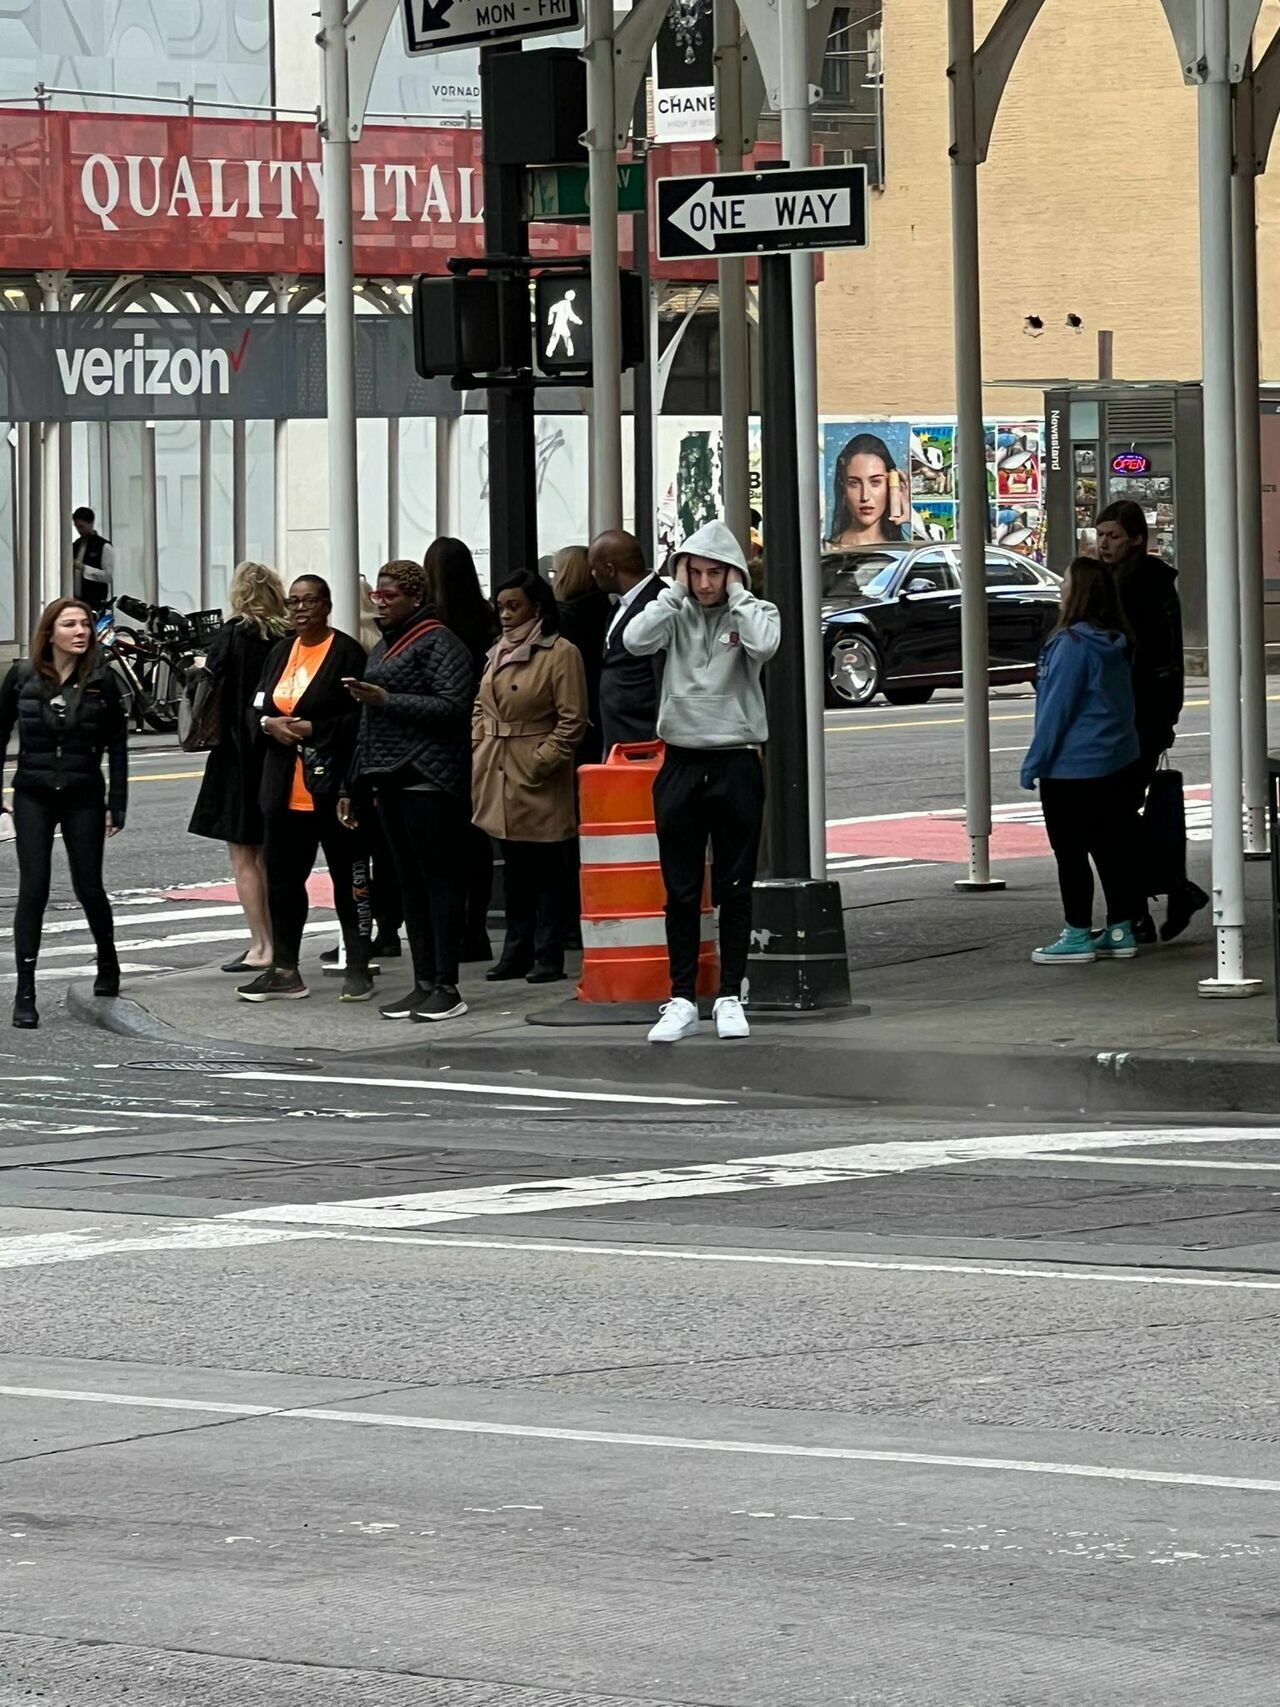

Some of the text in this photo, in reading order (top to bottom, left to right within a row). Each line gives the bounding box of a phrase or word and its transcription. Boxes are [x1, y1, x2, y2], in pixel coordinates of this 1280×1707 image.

[476, 2, 515, 26] MON
[539, 0, 566, 16] FRI
[432, 84, 480, 97] VORNAD
[360, 163, 485, 224] ITAL
[690, 192, 838, 232] ONE WAY
[55, 333, 230, 396] verizon
[1112, 458, 1147, 471] OPEN
